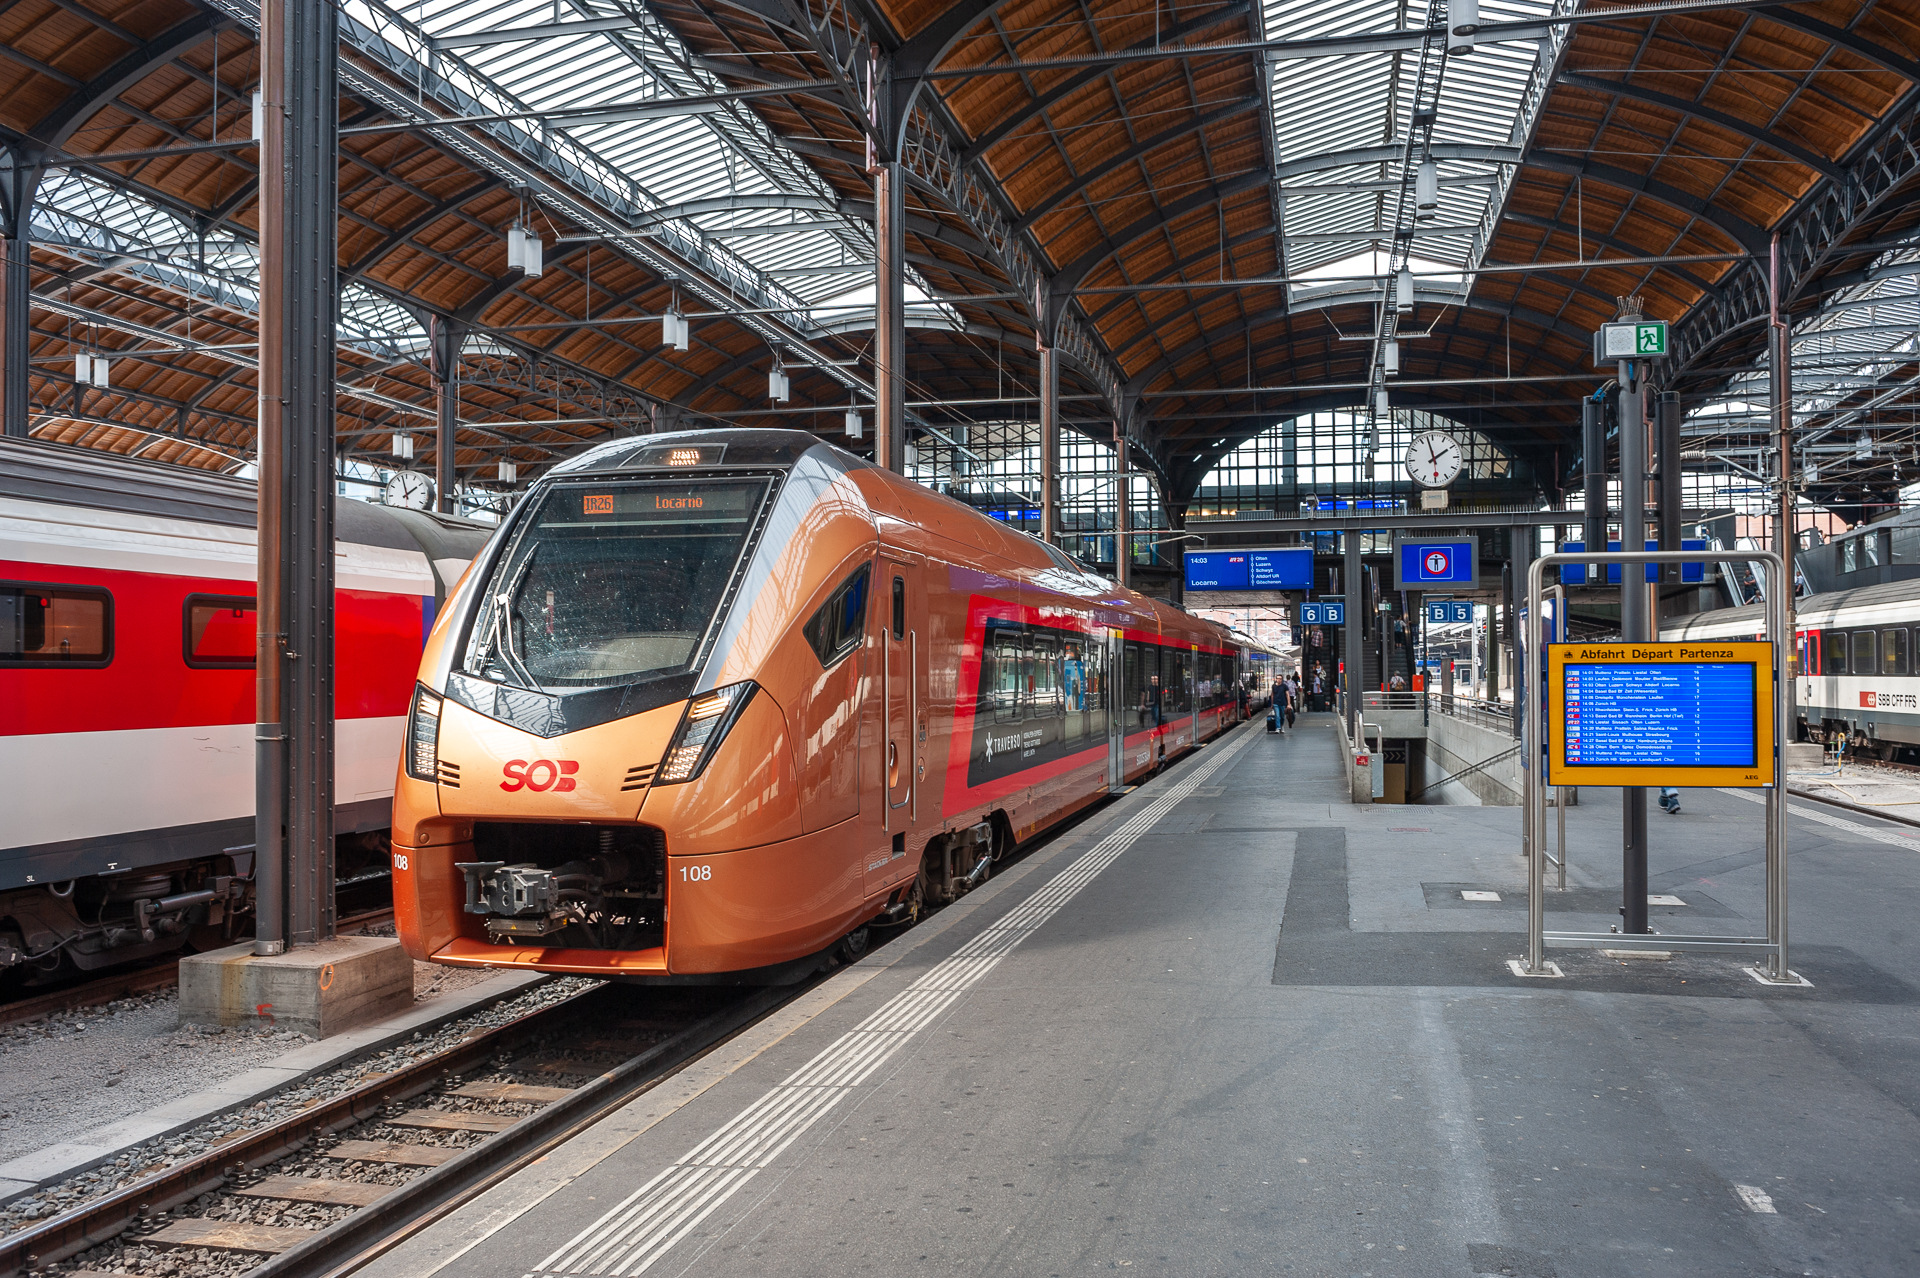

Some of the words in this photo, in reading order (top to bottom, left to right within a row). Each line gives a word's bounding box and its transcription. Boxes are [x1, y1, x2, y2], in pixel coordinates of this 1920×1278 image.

[585, 497, 612, 512] IR26
[655, 495, 703, 510] Locarno
[1307, 609, 1316, 621] 6
[1328, 609, 1338, 621] B
[1434, 608, 1444, 620] B
[1457, 608, 1466, 620] 5
[1580, 649, 1625, 660] Abfahrt
[1632, 648, 1673, 661] Départ
[1680, 648, 1734, 659] Partenza
[1878, 693, 1890, 706] SBB
[1892, 694, 1904, 707] CFF
[1904, 694, 1917, 708] FFS
[994, 734, 1021, 753] TRAVERSO
[499, 759, 579, 792] SOB
[393, 853, 408, 872] 108
[679, 866, 712, 882] 108
